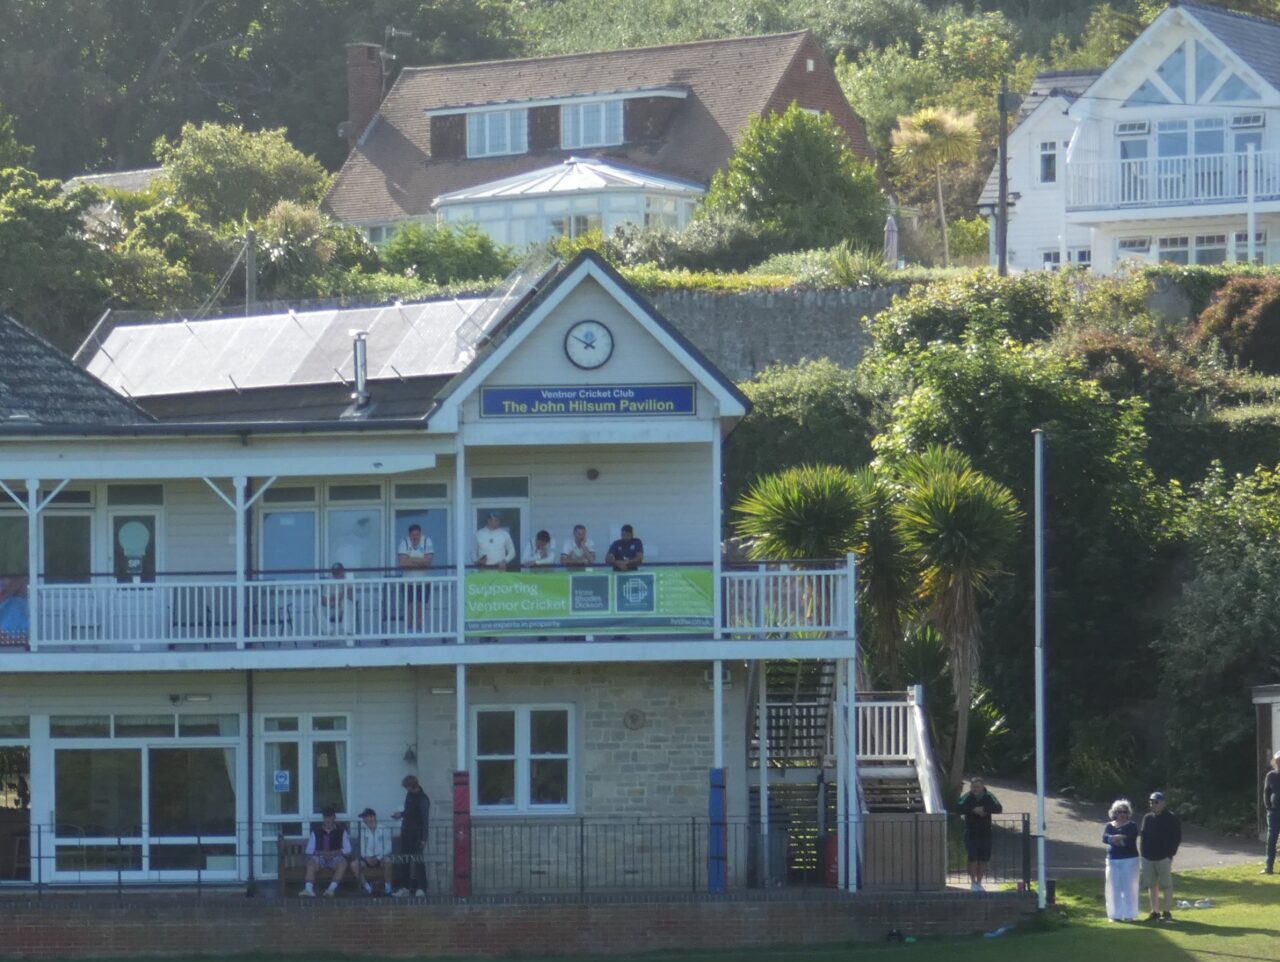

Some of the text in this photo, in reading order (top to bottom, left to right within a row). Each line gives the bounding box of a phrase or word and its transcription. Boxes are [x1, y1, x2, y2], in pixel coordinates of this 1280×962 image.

[540, 389, 636, 398] Ventnor Cricket Club
[502, 400, 674, 413] The John Hilsum Pavilion
[468, 583, 538, 597] Supporting
[468, 599, 567, 612] Ventnor Cricket
